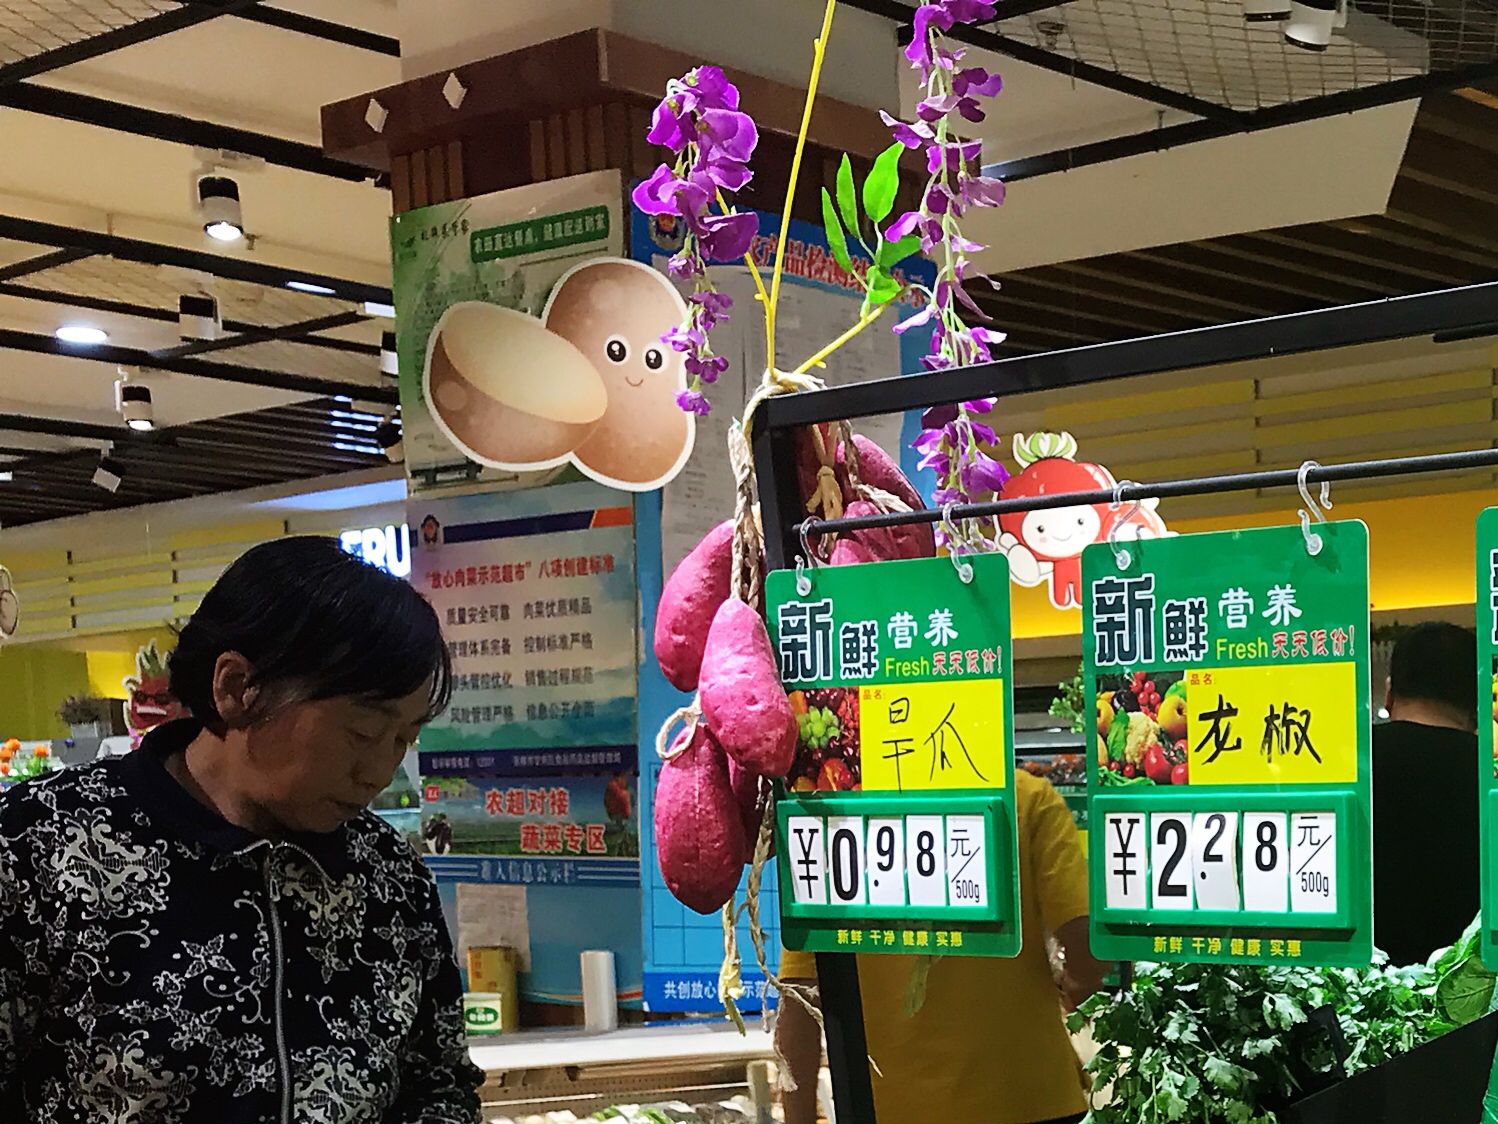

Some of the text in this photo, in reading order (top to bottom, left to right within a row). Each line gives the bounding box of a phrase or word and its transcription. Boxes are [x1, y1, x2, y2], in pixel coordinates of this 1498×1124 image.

[1218, 584, 1302, 629] 营养
[887, 608, 959, 649] 营养
[1216, 637, 1268, 660] Fresh
[885, 657, 930, 677] Fresh
[1194, 694, 1323, 764] 龙椒
[485, 787, 570, 817] 农超对接
[519, 823, 608, 854] 蔬菜专区
[837, 929, 963, 946] 新鲜 干净 健康 实惠
[1154, 936, 1302, 957] 新鲜 干净 健康 实惠
